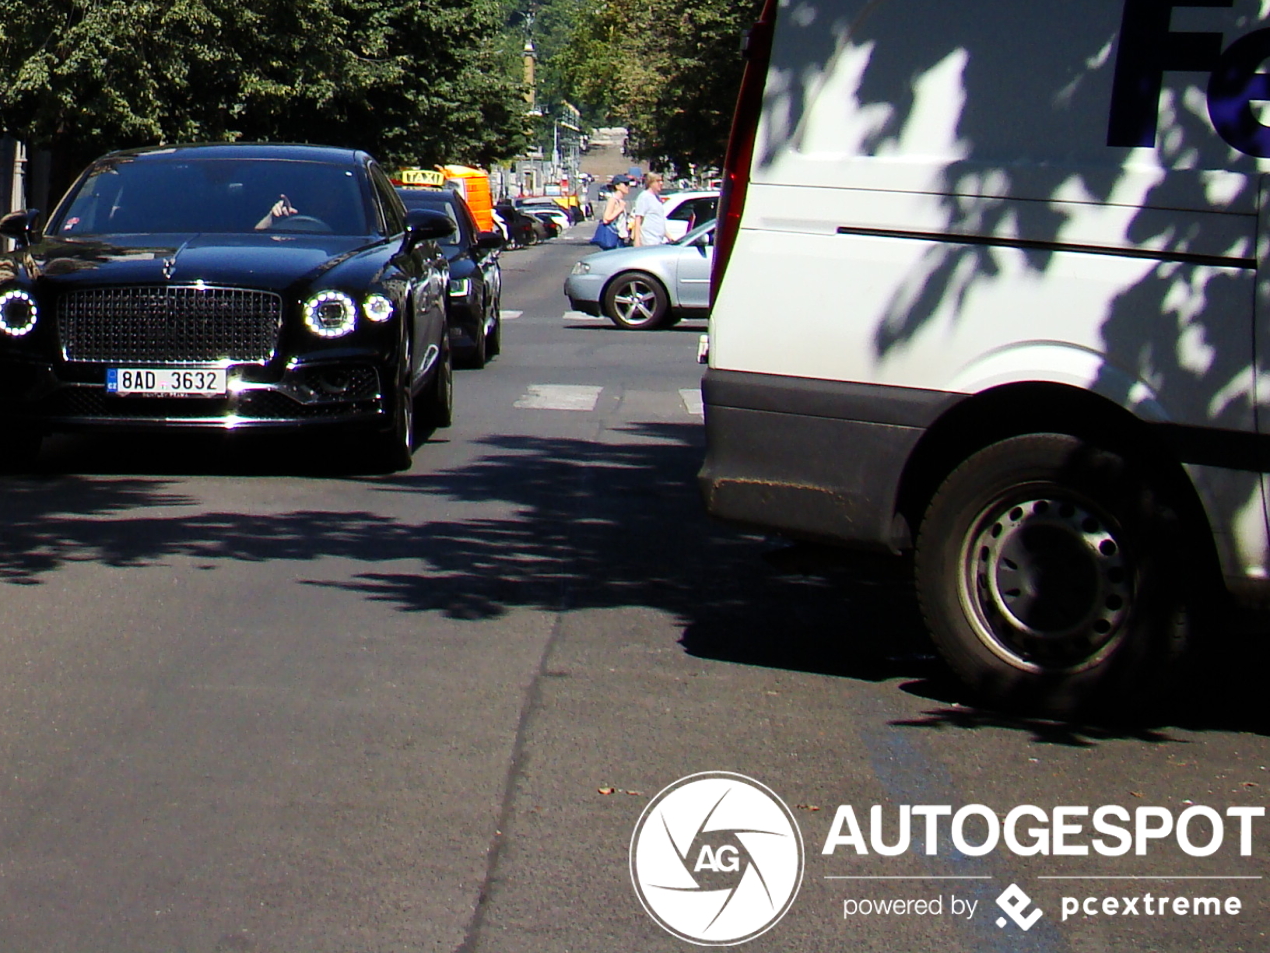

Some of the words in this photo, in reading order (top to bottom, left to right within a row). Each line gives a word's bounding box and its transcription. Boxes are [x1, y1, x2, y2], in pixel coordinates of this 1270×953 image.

[407, 172, 440, 184] TAXI
[122, 371, 156, 390] 8AD
[171, 372, 217, 390] 3632
